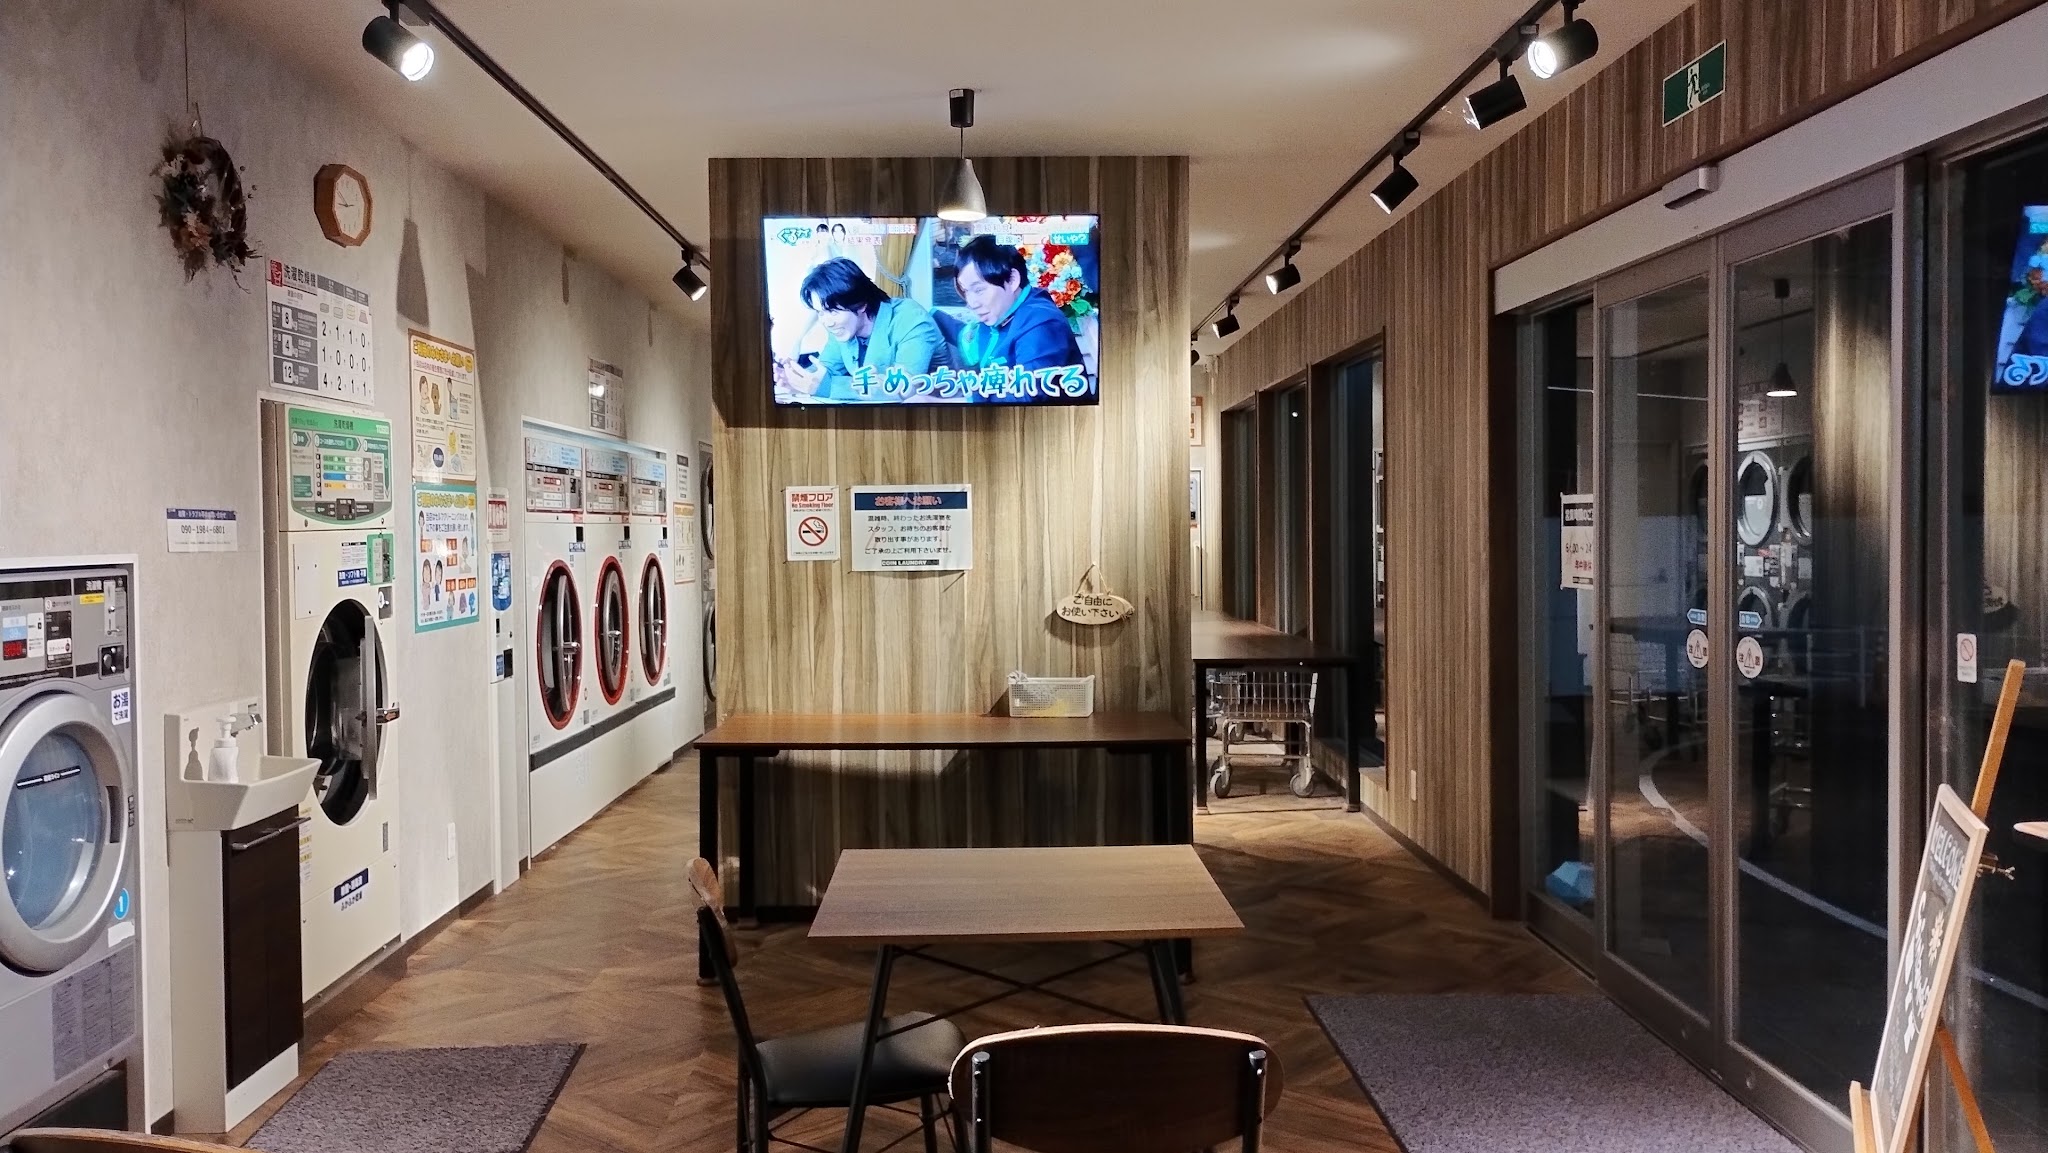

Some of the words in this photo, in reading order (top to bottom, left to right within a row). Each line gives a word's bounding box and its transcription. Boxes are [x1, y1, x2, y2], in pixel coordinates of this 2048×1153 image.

[791, 493, 833, 502] 禁煙フロア
[1073, 595, 1113, 606] ご自由に
[1061, 606, 1119, 618] お使い下さい
[113, 692, 128, 709] お湯
